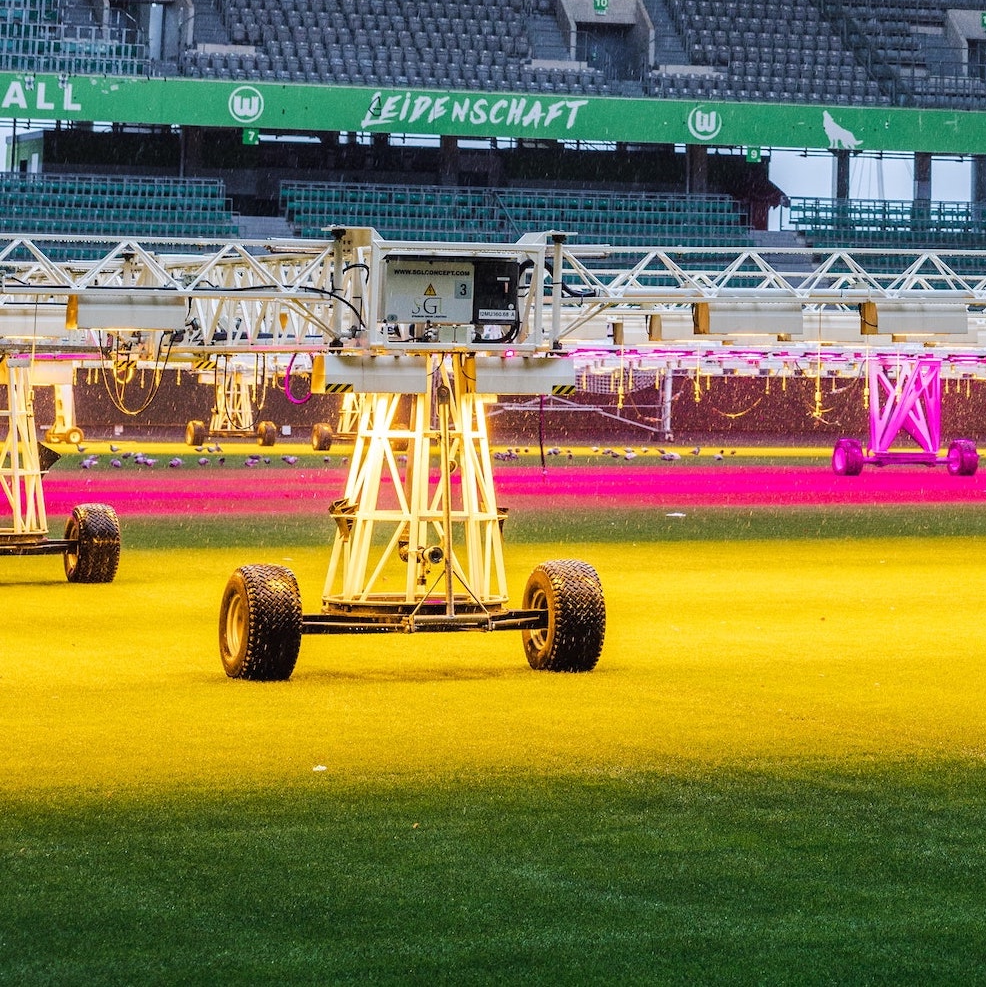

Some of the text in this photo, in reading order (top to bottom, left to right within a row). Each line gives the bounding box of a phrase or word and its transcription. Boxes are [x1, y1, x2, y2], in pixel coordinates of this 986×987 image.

[1, 81, 82, 112] ALL
[248, 131, 256, 141] 7
[750, 149, 758, 159] 9
[459, 283, 468, 296] 3
